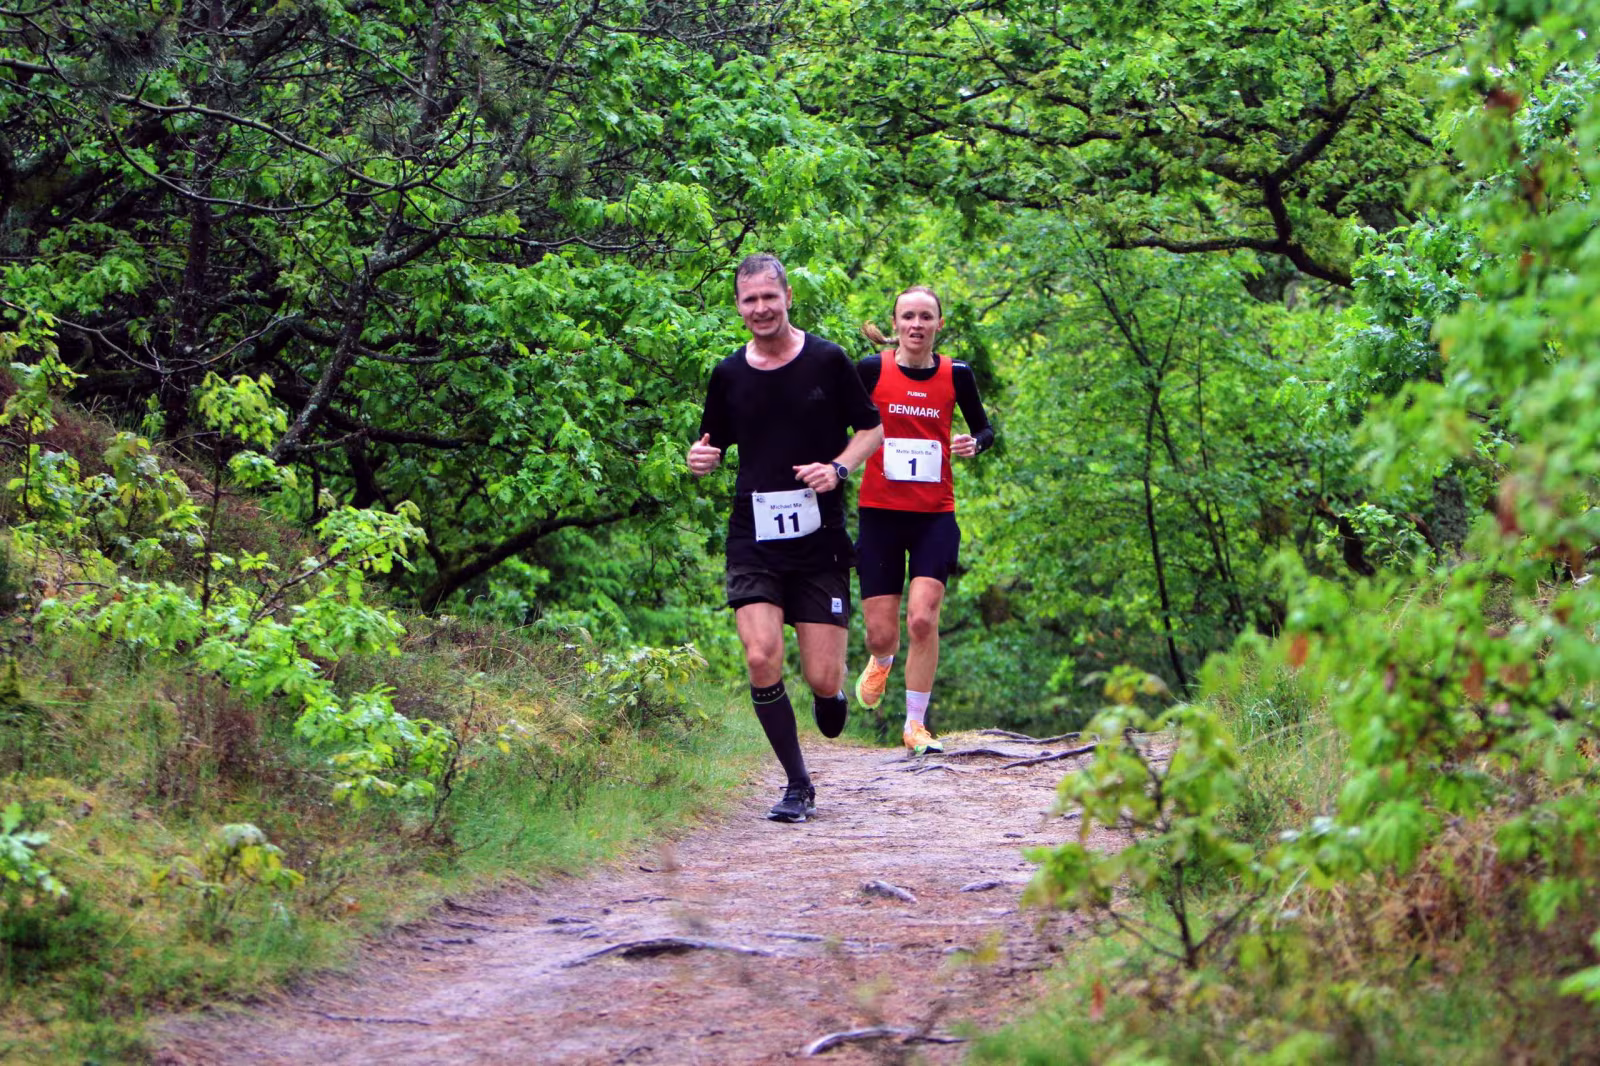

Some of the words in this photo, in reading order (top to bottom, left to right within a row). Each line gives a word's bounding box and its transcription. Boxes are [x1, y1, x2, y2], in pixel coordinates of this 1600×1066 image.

[907, 390, 927, 398] FUSION
[888, 403, 940, 419] DENMARK
[908, 457, 917, 476] 1
[774, 512, 800, 534] 11
